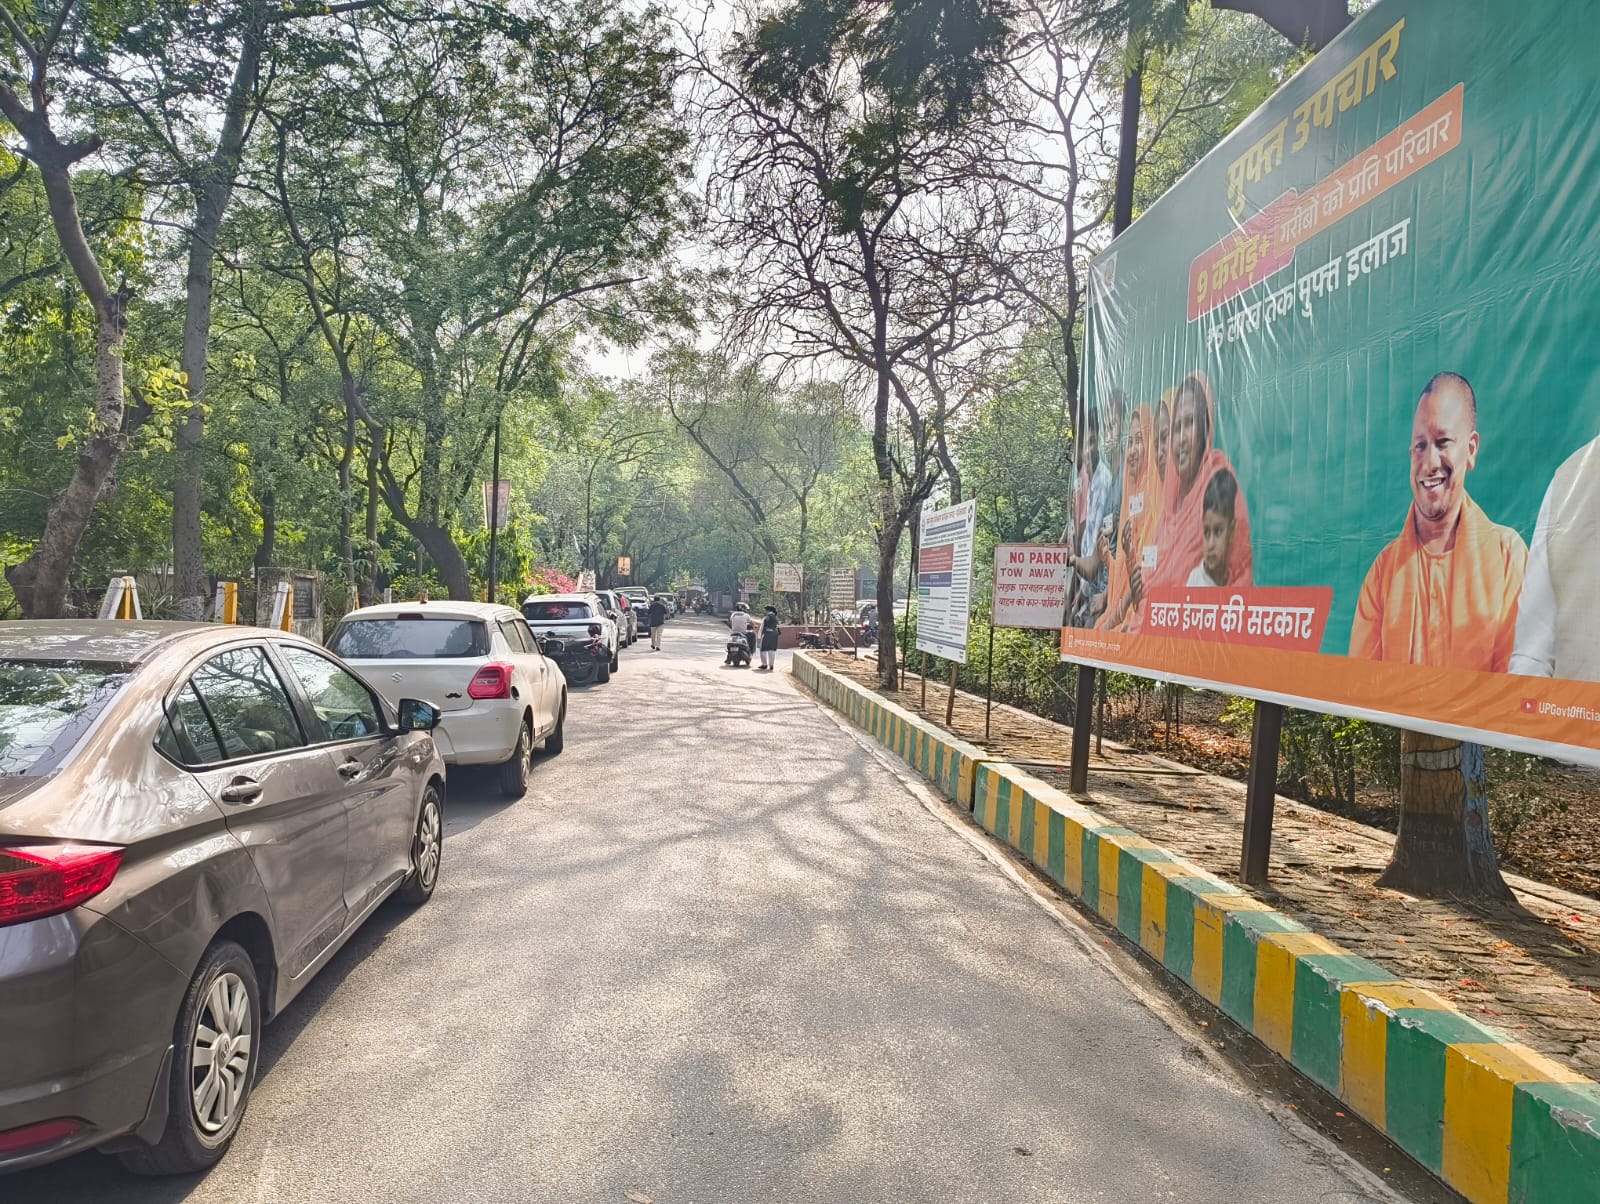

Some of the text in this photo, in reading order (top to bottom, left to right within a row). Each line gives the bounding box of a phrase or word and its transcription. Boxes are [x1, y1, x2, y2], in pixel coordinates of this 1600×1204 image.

[1226, 17, 1406, 218] मुफ्त उपचार
[1279, 111, 1453, 243] गरीबों को प्रति परिवार
[1197, 270, 1208, 303] 9
[1227, 301, 1263, 343] लाख
[1263, 283, 1296, 324] तक
[1297, 256, 1342, 318] मुफ्त
[1346, 217, 1411, 287] इलाज
[1000, 567, 1023, 577] TOW
[1028, 568, 1055, 579] AWAY
[1009, 551, 1025, 564] NO
[1150, 594, 1316, 640] डबल इंजन की सरकार
